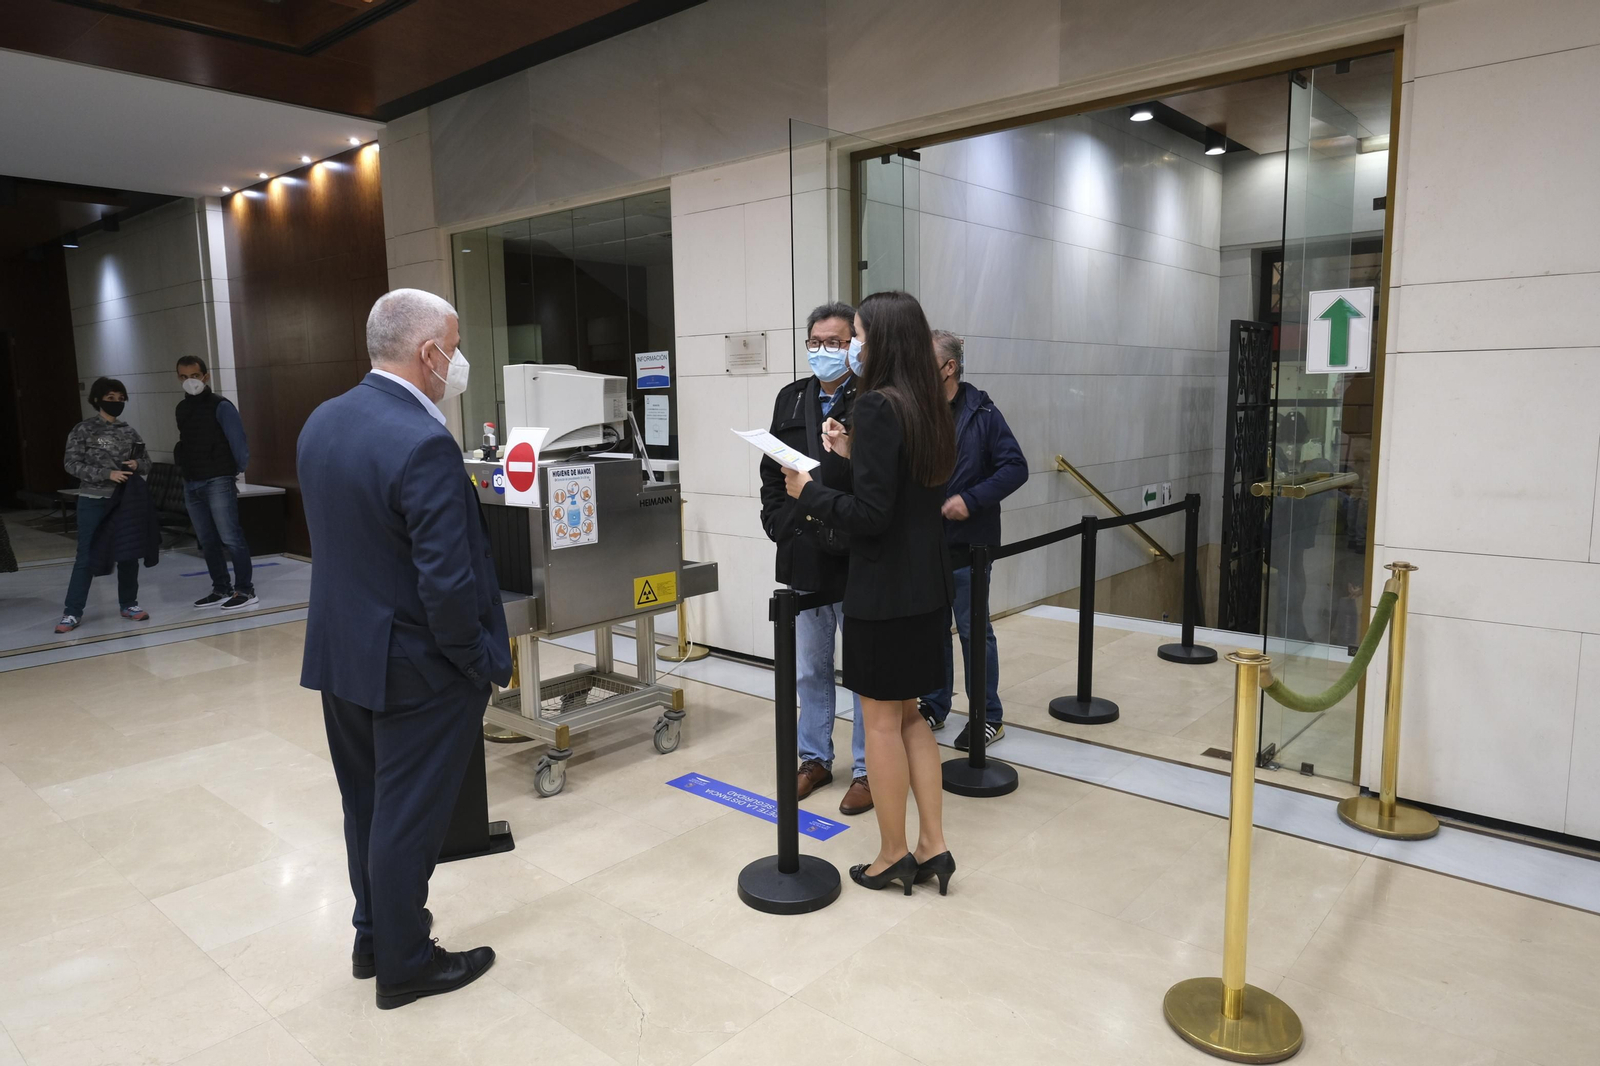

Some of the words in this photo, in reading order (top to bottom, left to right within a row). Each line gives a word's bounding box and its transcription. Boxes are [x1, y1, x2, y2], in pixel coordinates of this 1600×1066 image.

[637, 354, 668, 362] INFORMACIÓN
[552, 469, 570, 477] HIGIENE
[570, 468, 577, 476] DE
[577, 467, 591, 475] MANOS
[639, 496, 672, 507] HEIMANN
[705, 788, 746, 806] DISTANCIA
[727, 790, 775, 809] SEGURIDAD
[757, 808, 778, 818] PETE
